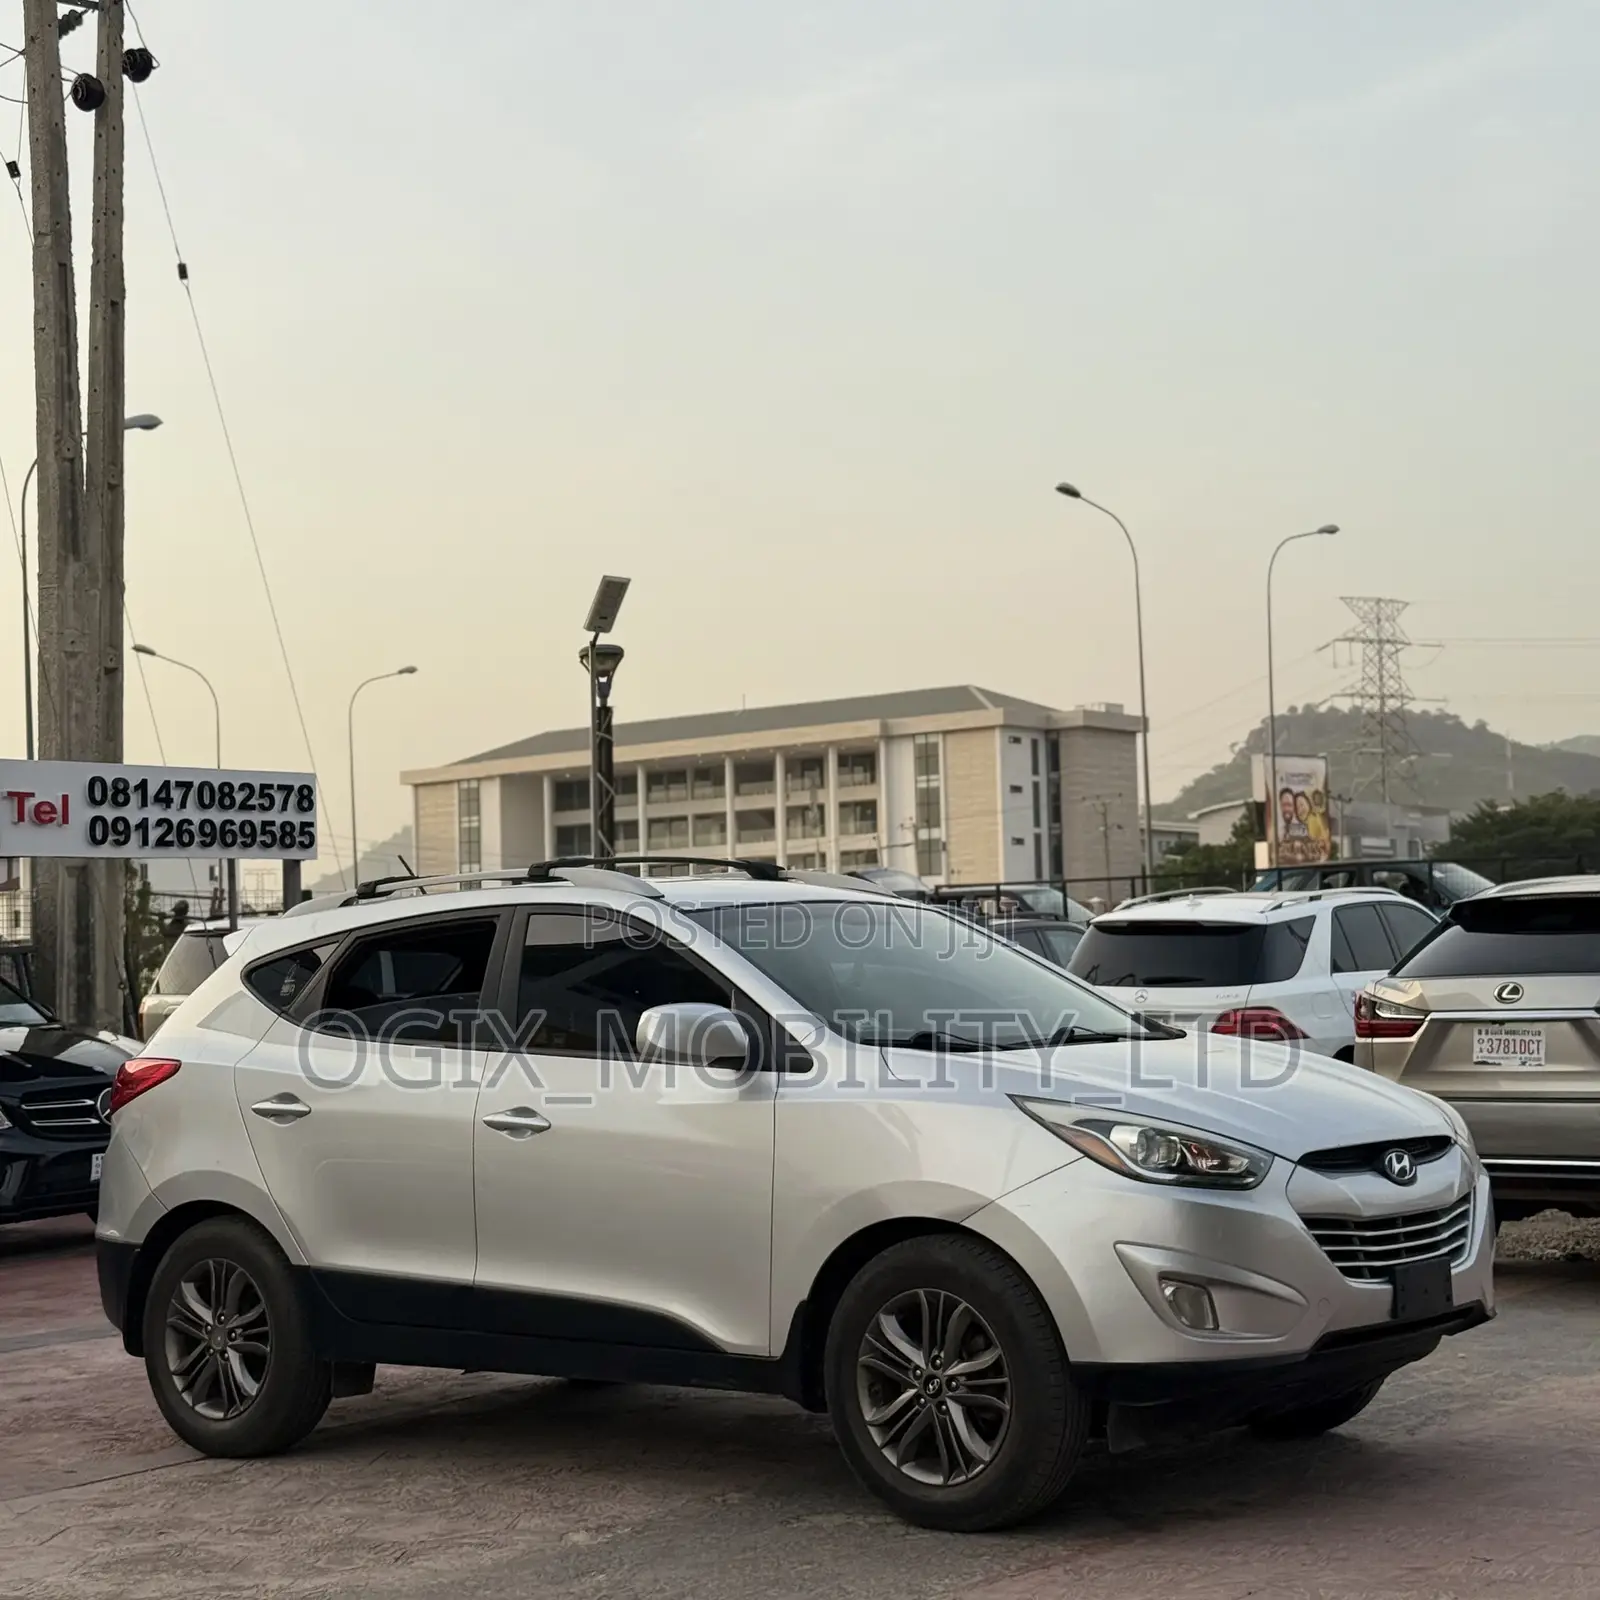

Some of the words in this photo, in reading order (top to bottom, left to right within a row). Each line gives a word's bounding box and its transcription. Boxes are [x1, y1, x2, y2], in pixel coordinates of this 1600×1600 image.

[4, 790, 70, 826] Tel
[86, 775, 315, 812] 08147082578
[87, 815, 316, 850] 09126969585
